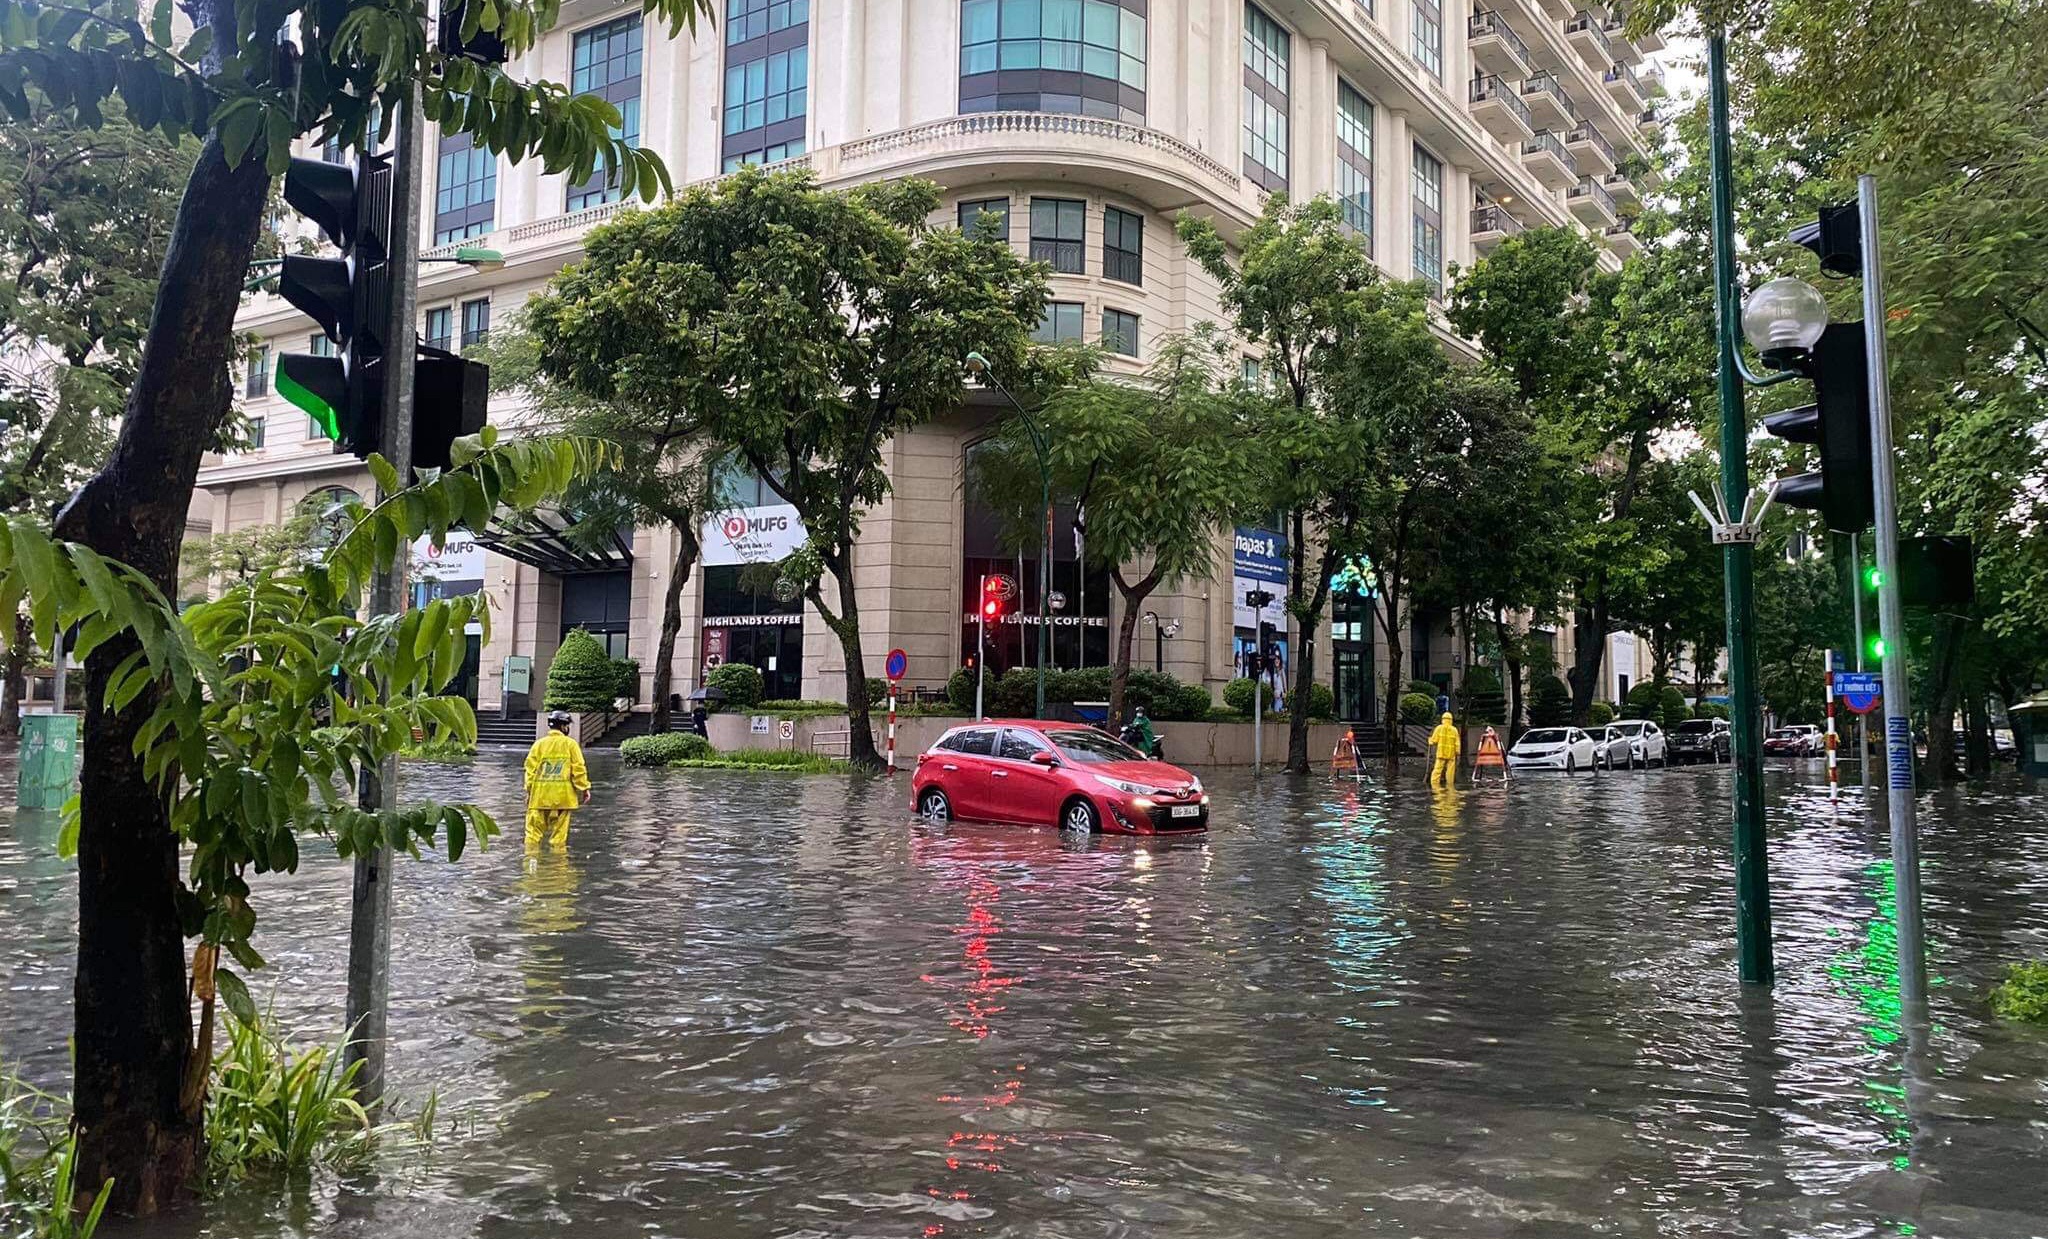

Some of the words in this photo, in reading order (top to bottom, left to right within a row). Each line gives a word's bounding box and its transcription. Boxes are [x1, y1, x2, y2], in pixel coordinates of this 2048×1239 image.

[747, 517, 787, 532] MUFG
[444, 542, 474, 554] MUFG
[1235, 535, 1265, 557] napas
[704, 616, 762, 627] HIGHLANDS
[763, 615, 801, 625] COFFEE
